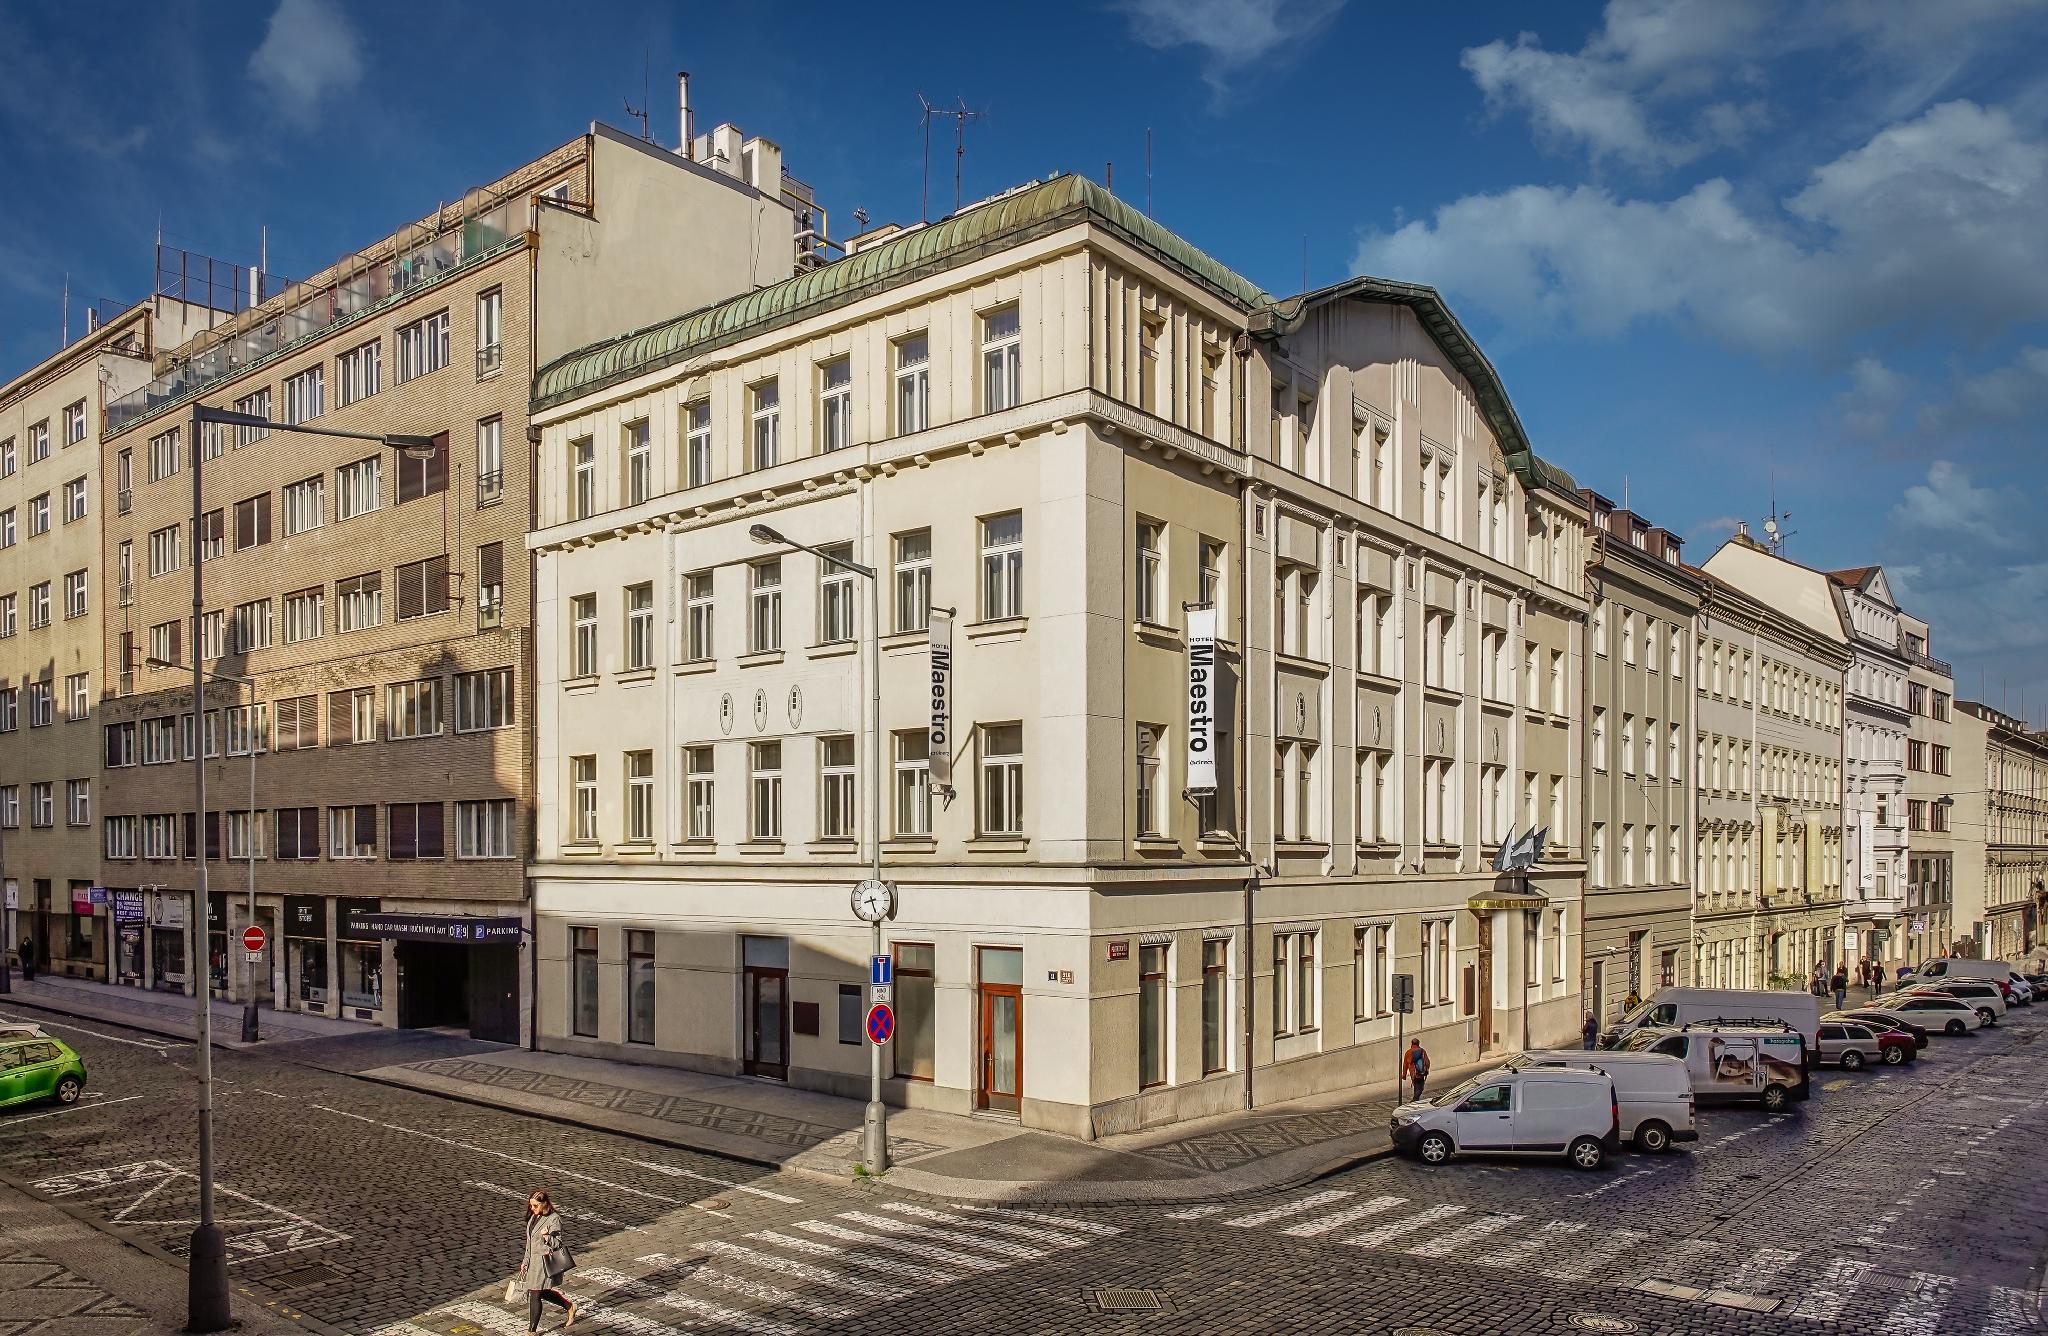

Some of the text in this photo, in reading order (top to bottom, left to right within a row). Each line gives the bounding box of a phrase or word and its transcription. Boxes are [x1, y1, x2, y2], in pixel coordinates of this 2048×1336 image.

[931, 650, 950, 745] Maestro
[1189, 644, 1214, 753] Maestro
[116, 891, 143, 902] CHANGE
[486, 927, 519, 935] PARKING
